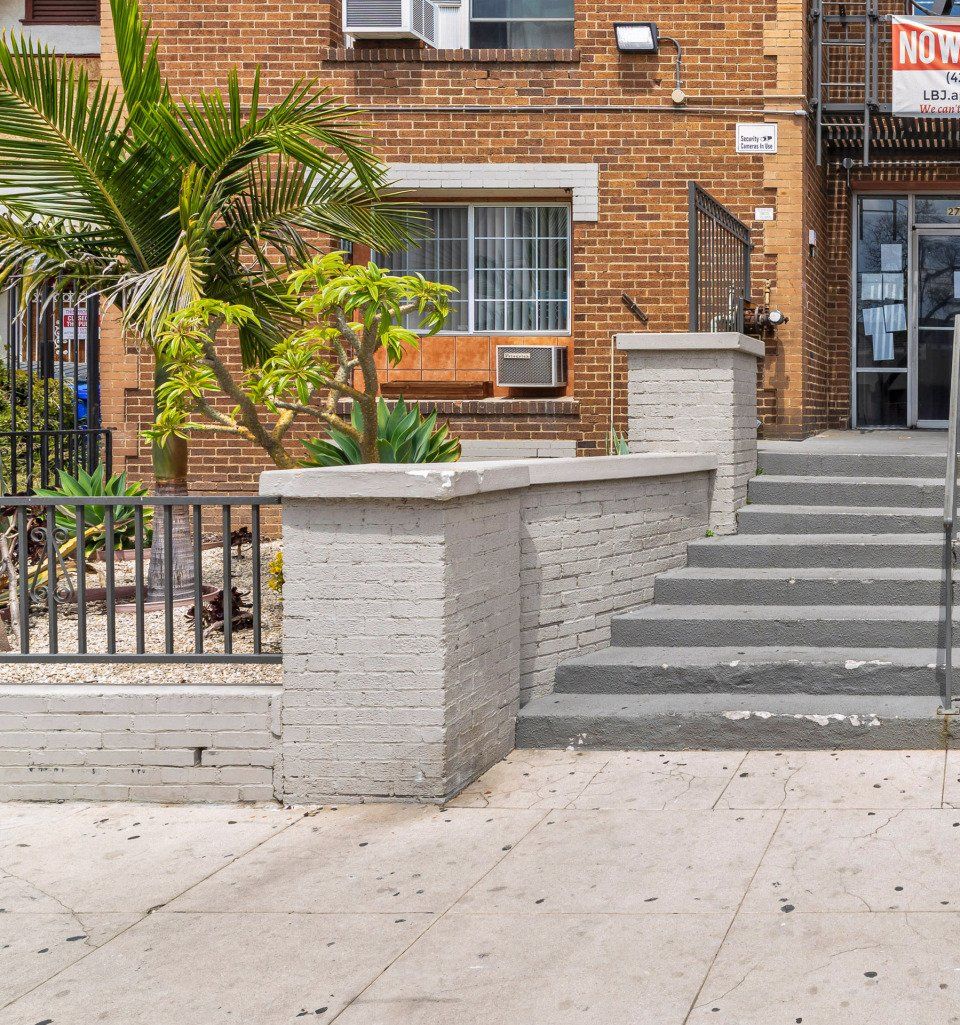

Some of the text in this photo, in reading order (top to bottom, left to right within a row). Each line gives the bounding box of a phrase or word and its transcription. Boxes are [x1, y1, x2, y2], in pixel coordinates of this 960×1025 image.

[899, 30, 960, 64] NOW
[920, 104, 935, 114] We
[937, 104, 960, 114] can't
